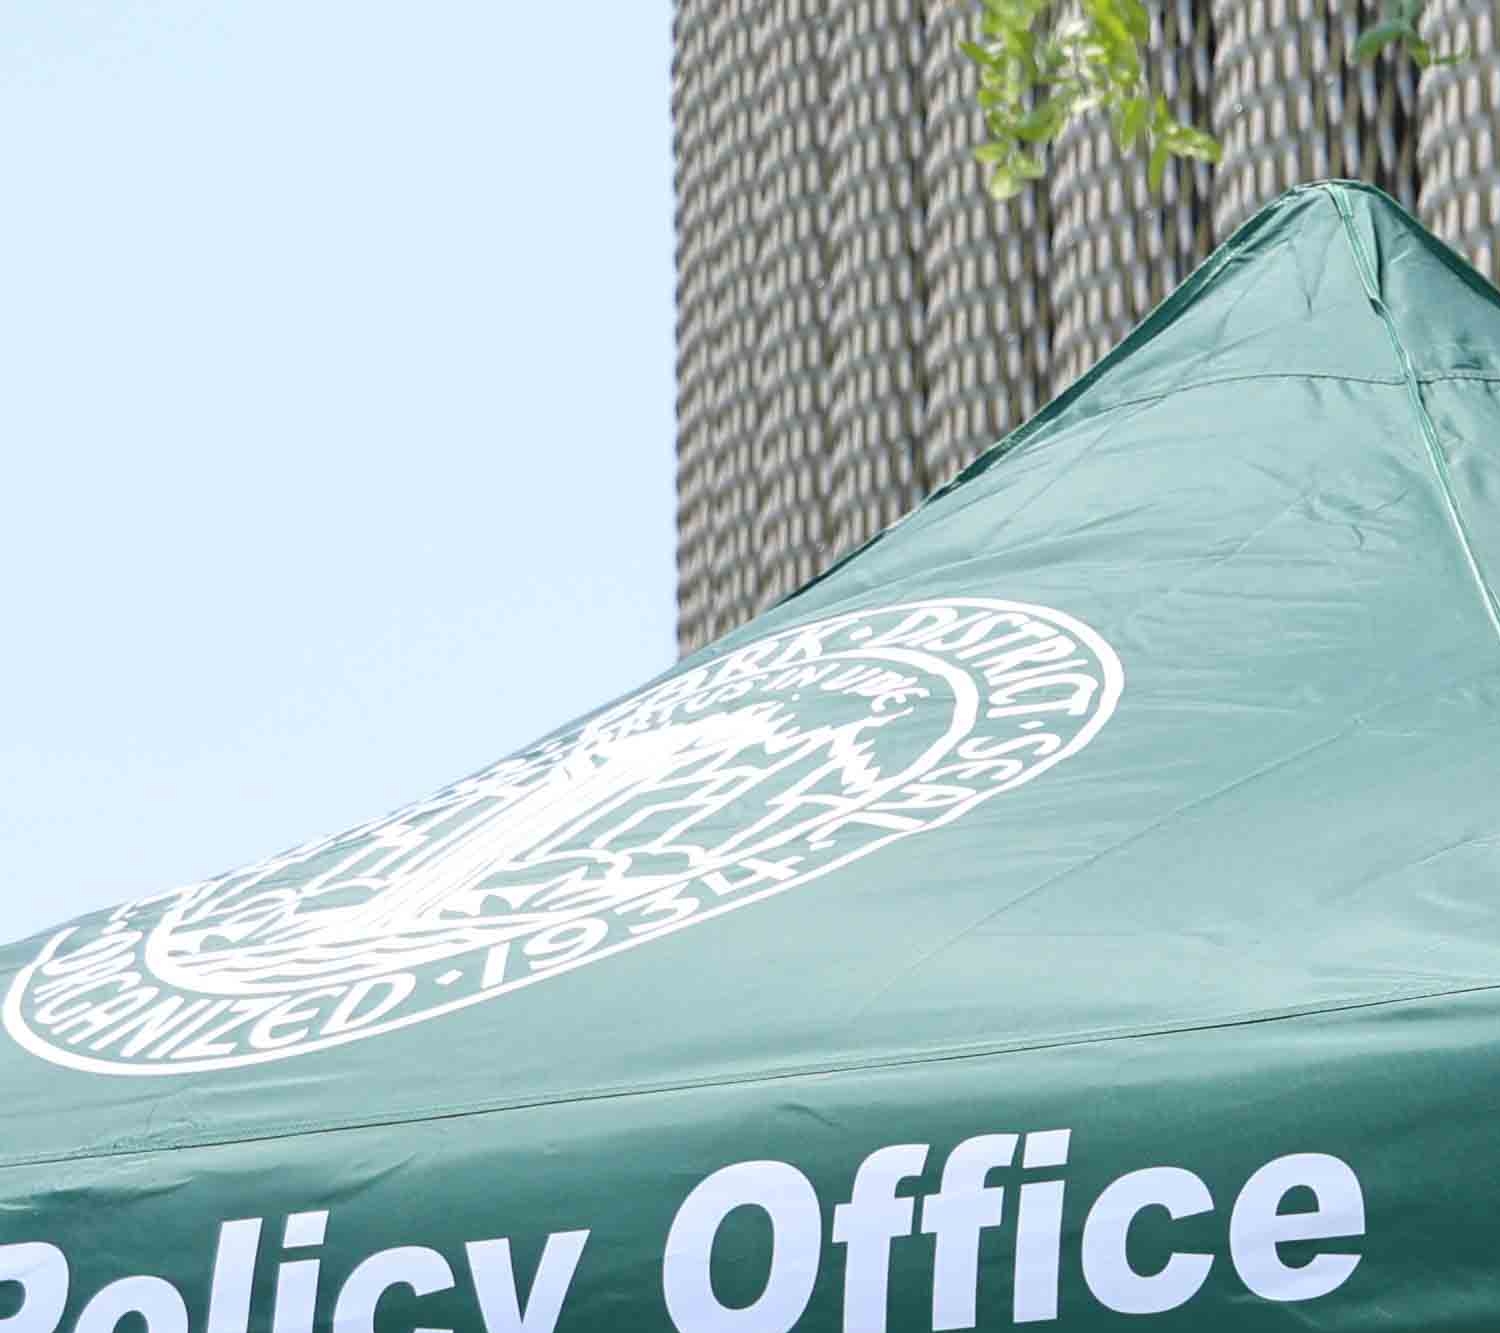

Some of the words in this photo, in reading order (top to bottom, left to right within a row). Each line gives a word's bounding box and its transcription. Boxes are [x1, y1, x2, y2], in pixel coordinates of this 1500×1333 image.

[860, 607, 1100, 719] DISTRICT
[806, 733, 1061, 841] SEAL
[33, 929, 417, 1059] ORGANIZED
[481, 856, 806, 989] 1934
